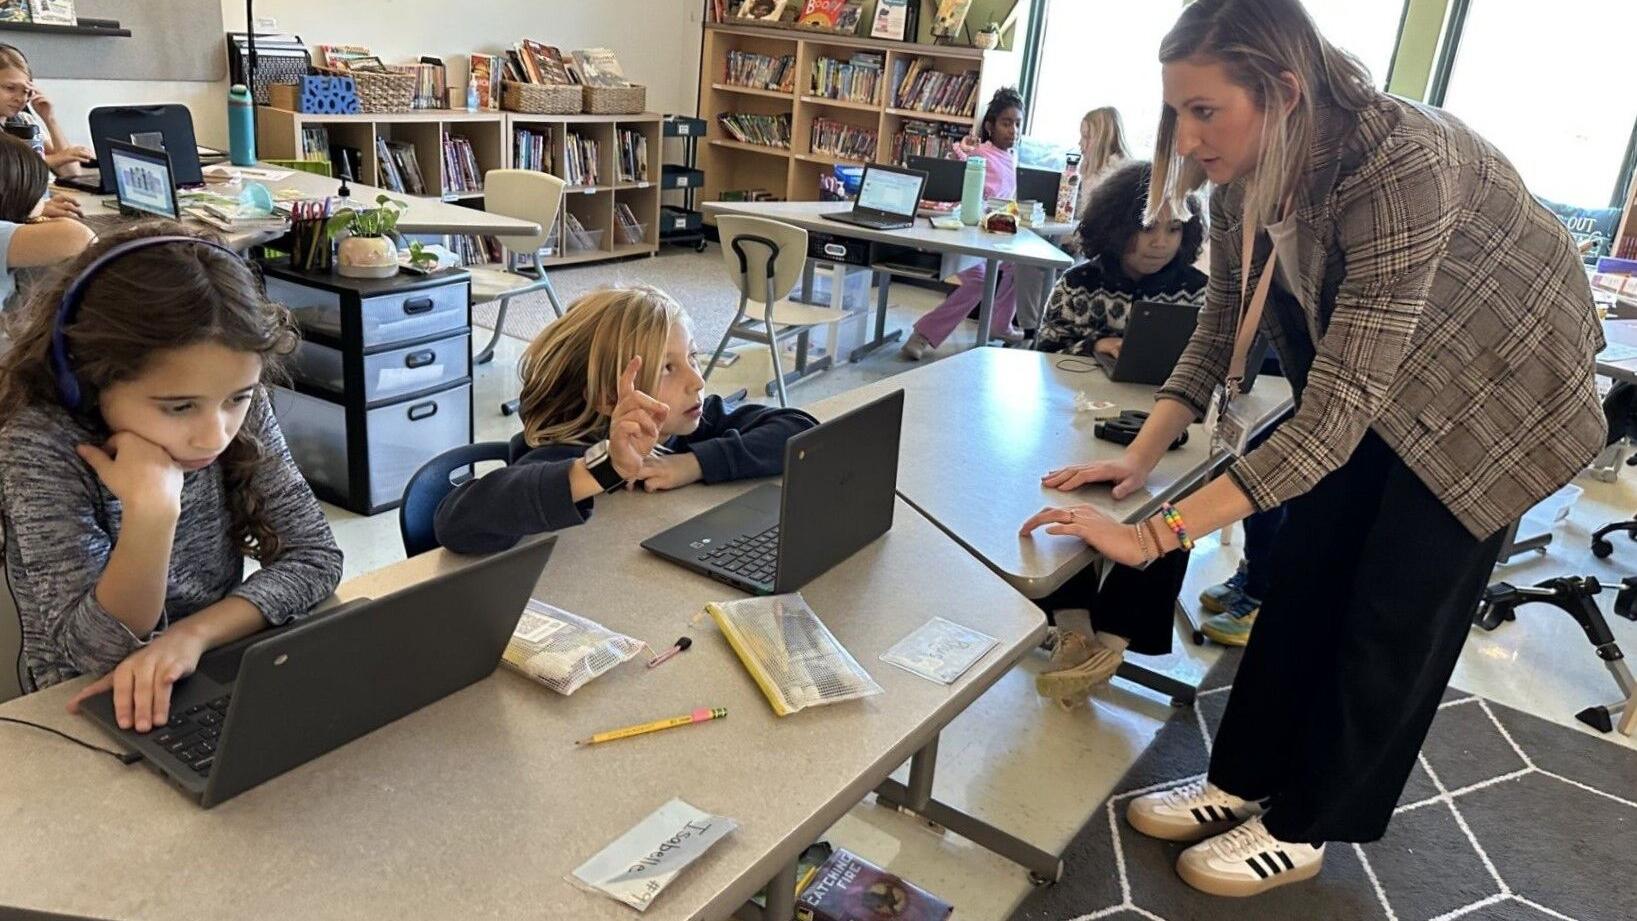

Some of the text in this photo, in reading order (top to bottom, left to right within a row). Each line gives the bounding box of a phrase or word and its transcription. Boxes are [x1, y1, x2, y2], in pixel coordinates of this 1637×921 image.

[304, 76, 355, 97] READ
[303, 95, 358, 114] BOOKS
[1567, 216, 1597, 232] OUT
[628, 820, 712, 873] Isabelle
[806, 853, 854, 906] CATCHING
[836, 862, 862, 890] FIRE
